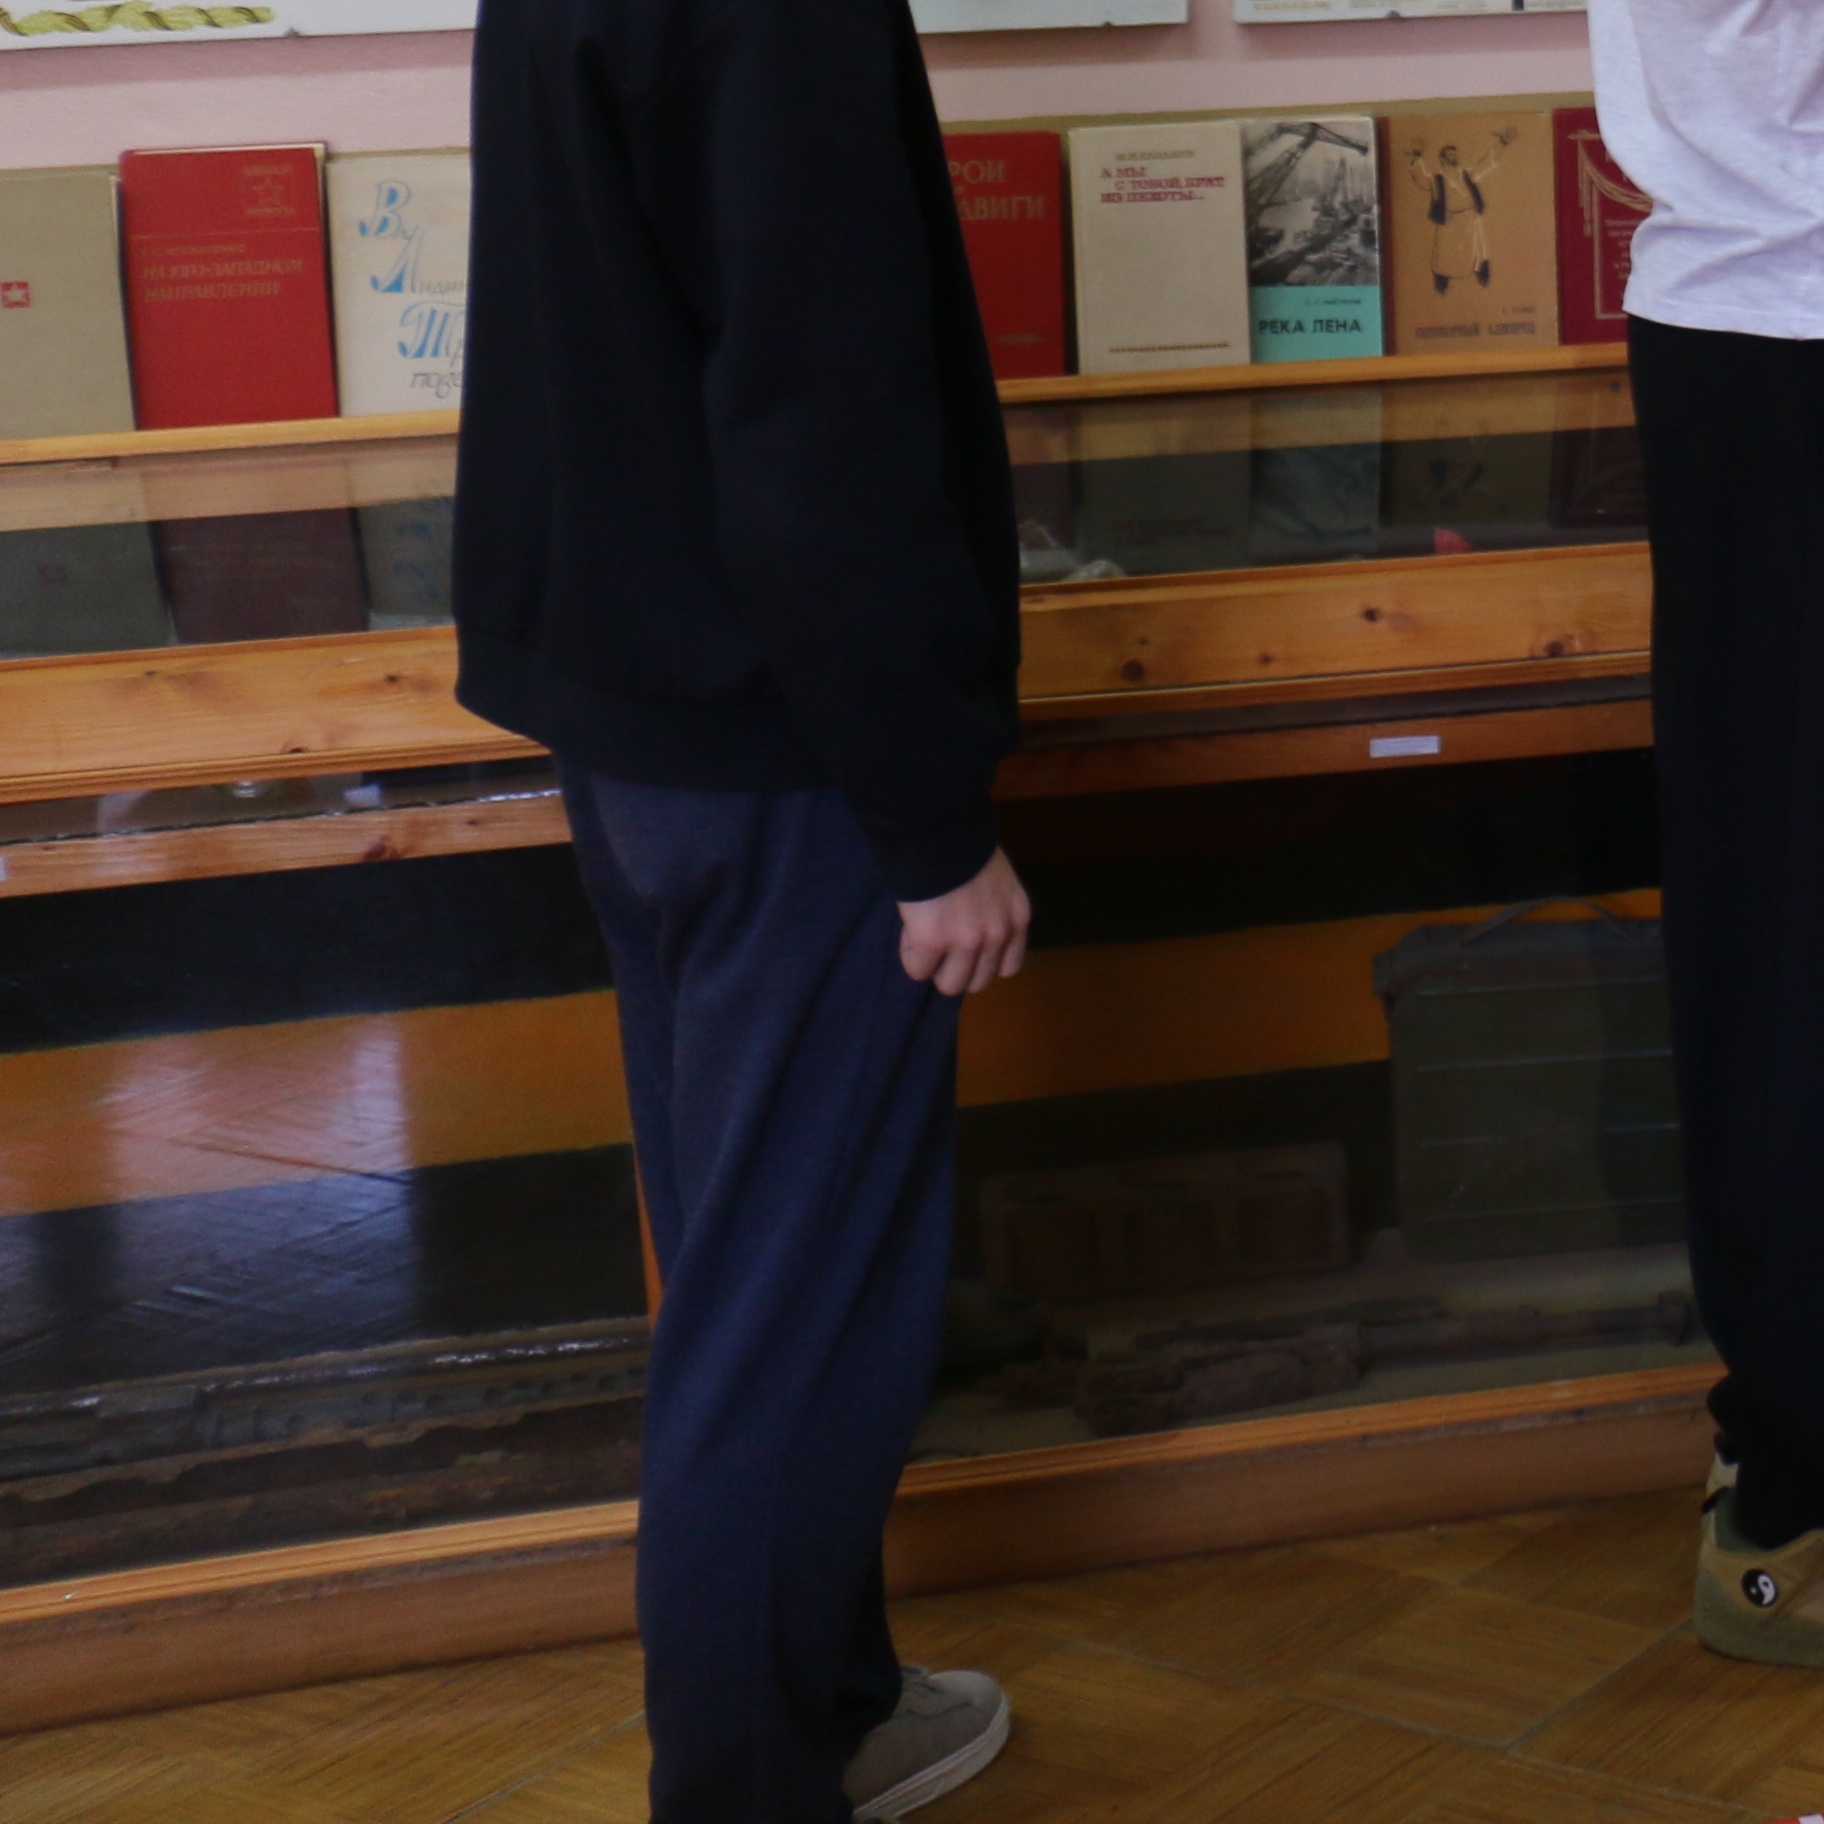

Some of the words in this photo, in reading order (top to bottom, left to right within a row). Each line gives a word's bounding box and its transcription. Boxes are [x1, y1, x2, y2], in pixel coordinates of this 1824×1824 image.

[1101, 168, 1111, 178] А
[1117, 167, 1146, 178] МЫ
[1116, 180, 1125, 190] С
[1259, 319, 1305, 334] РЕКА
[1312, 319, 1361, 334] ЛЕНА
